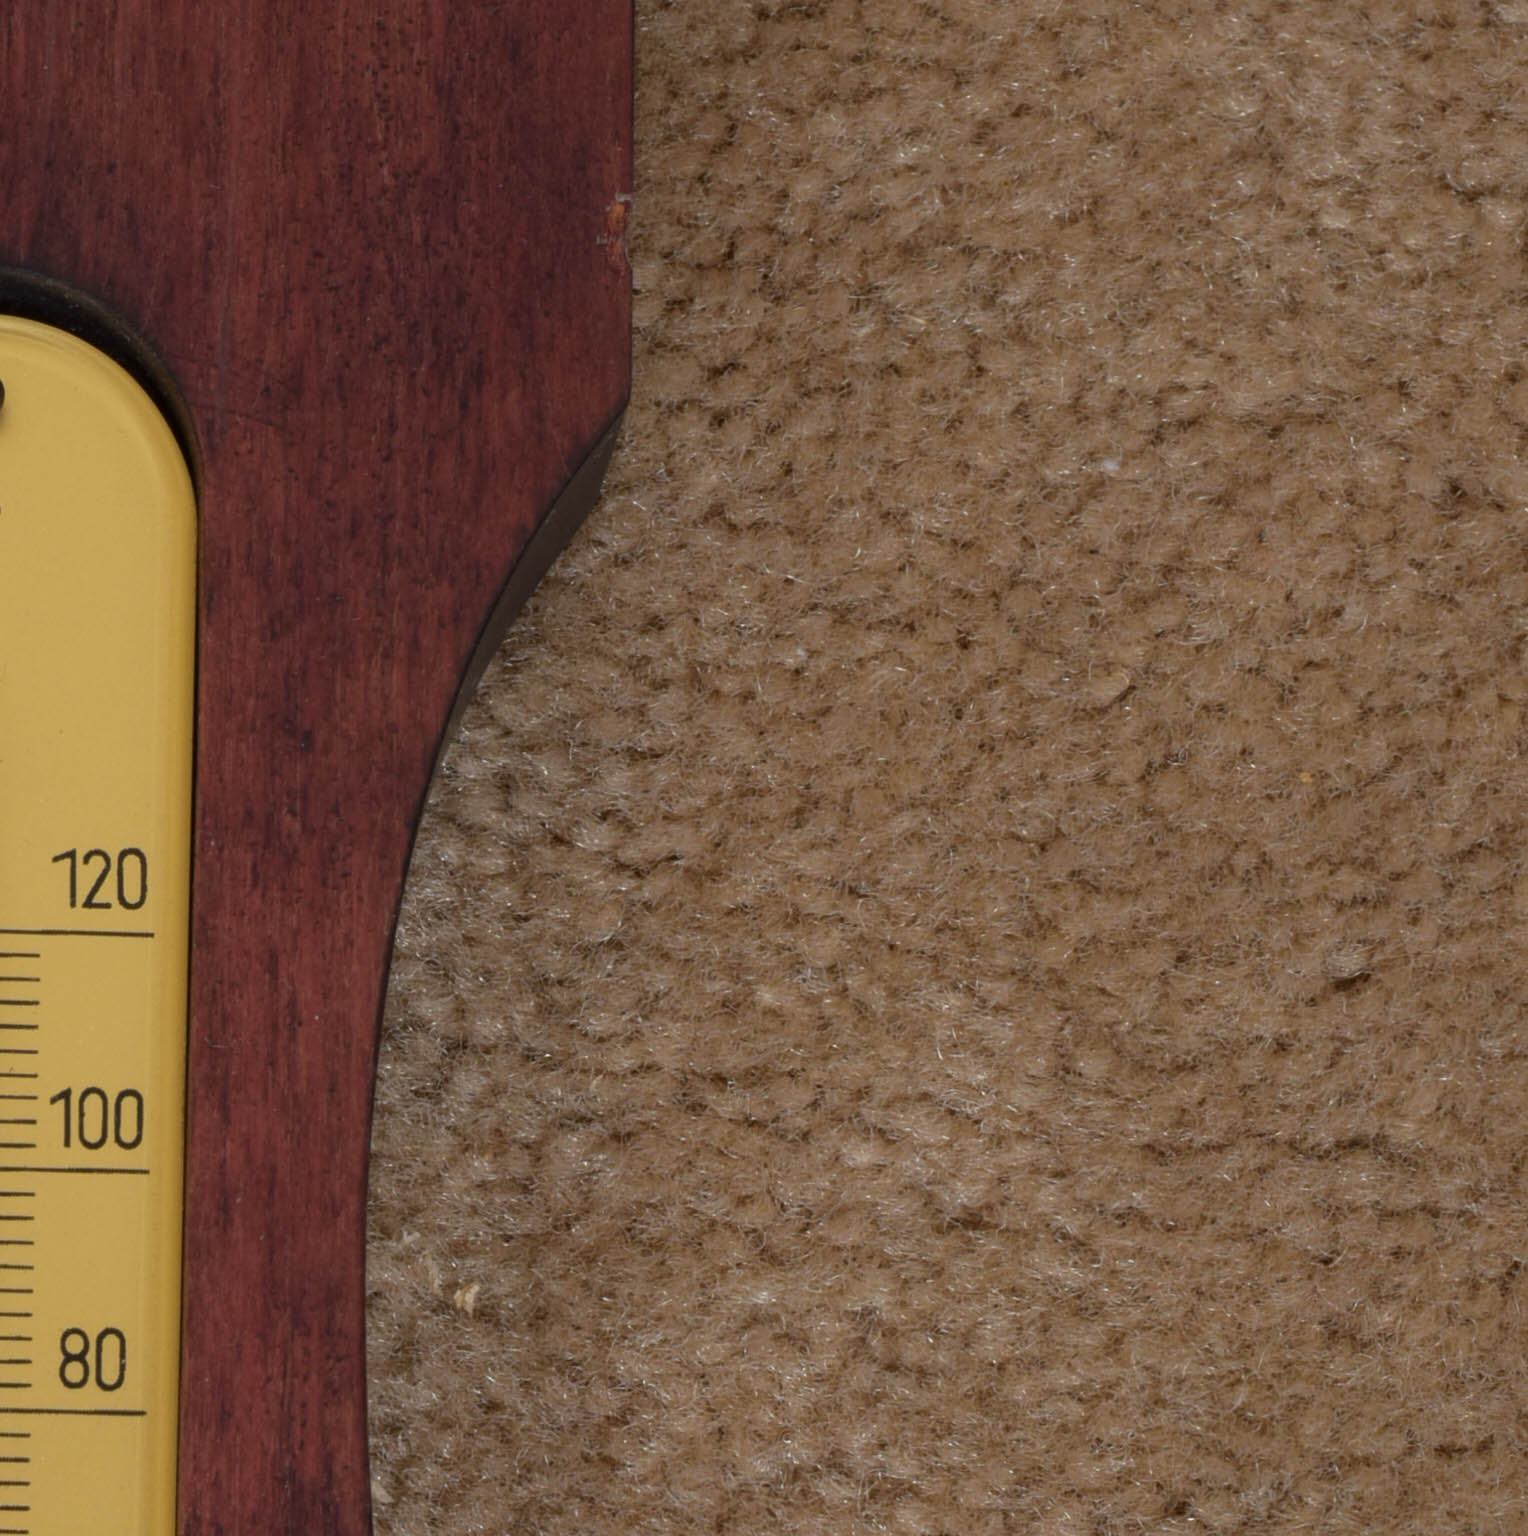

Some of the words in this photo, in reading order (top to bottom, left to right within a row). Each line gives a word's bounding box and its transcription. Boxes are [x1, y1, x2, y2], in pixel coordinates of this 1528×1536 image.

[52, 848, 147, 910] 120
[50, 1087, 144, 1150] 100
[59, 1328, 126, 1391] 80
